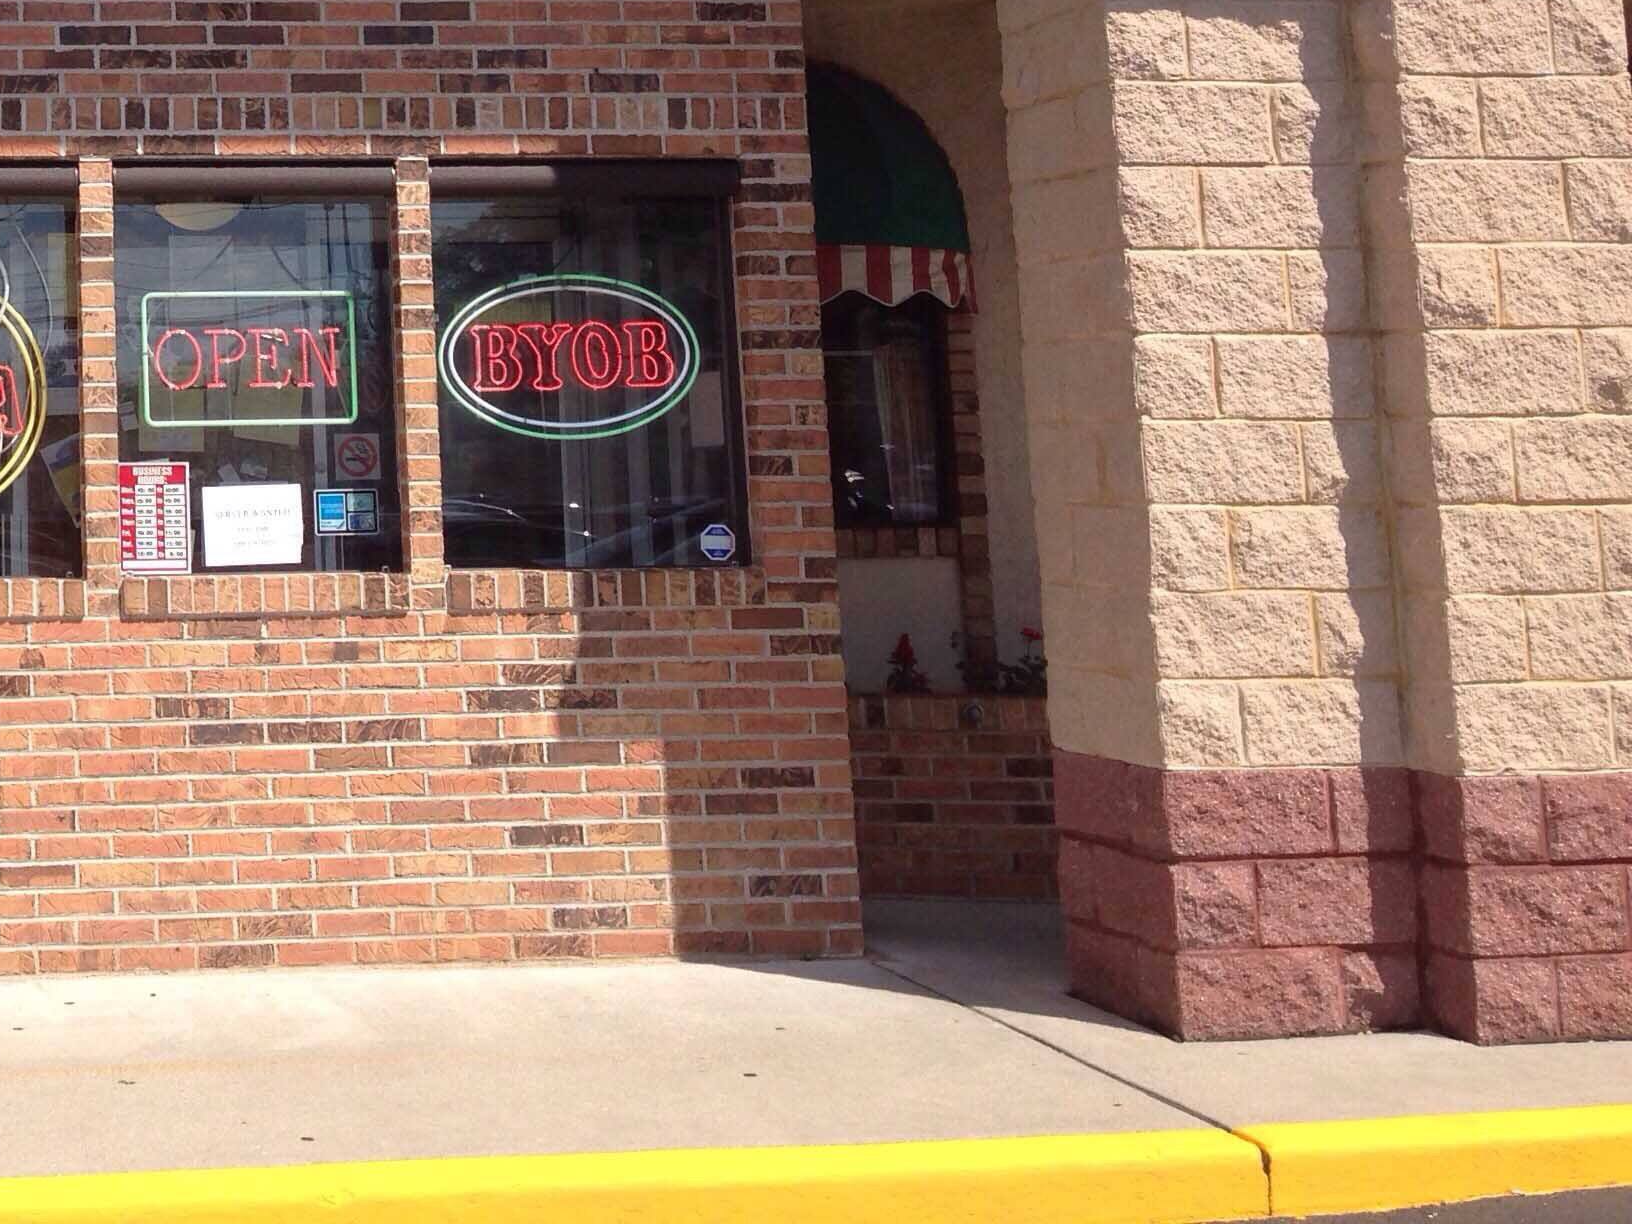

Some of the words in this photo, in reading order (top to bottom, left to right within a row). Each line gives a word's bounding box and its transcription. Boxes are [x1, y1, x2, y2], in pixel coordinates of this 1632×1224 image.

[154, 327, 341, 391] OPEN
[470, 321, 675, 392] BYOB
[132, 466, 173, 476] BUSINESS
